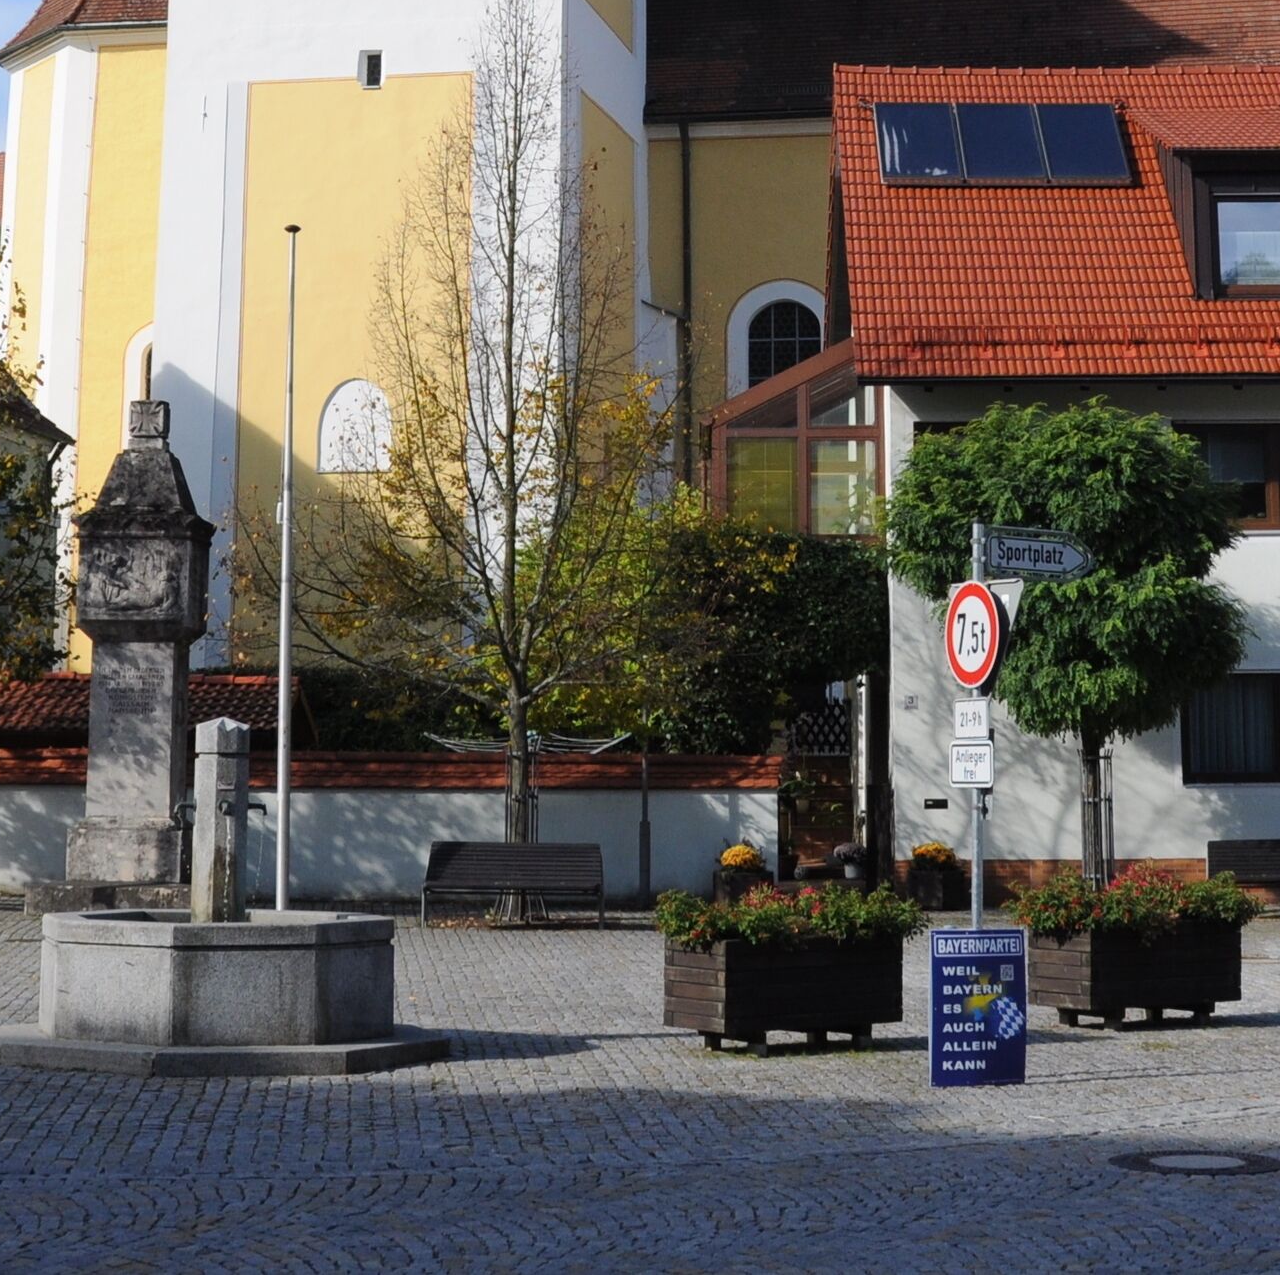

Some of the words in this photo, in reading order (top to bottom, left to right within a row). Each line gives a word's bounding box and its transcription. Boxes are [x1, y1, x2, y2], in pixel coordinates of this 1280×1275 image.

[997, 541, 1064, 567] Sportplatz
[907, 696, 914, 704] 3
[955, 749, 987, 767] Anlieger
[963, 767, 977, 780] frei
[938, 938, 1020, 954] BAYERNPARTEI
[942, 966, 980, 976] WEIL
[943, 984, 1003, 995] BAYERN
[943, 1004, 962, 1014] ES
[942, 1023, 985, 1033] AUCH
[942, 1041, 997, 1052] ALLEIN
[942, 1060, 986, 1071] KANN
